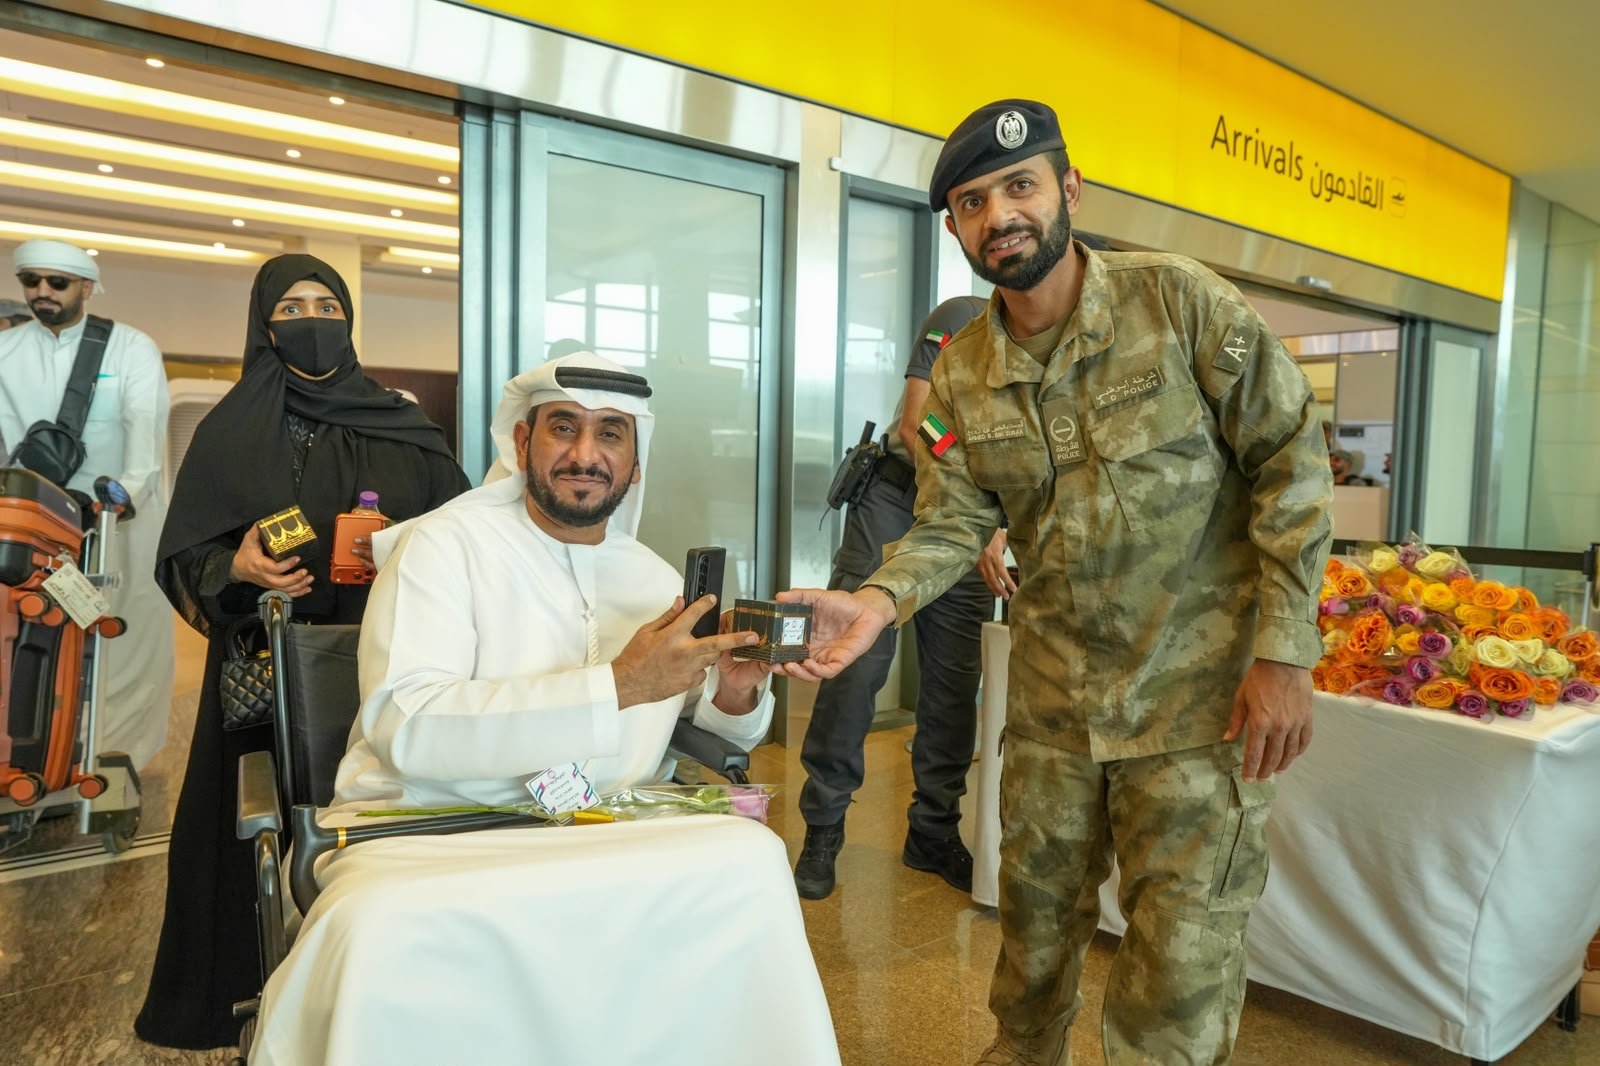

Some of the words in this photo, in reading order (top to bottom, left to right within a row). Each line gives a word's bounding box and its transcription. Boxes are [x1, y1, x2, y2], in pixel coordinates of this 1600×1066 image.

[1210, 114, 1304, 181] Arrivals
[1310, 161, 1385, 211] القادمون
[1223, 335, 1248, 363] A+
[1123, 379, 1160, 397] POLICE
[1055, 441, 1080, 453] الشرطة
[1056, 450, 1081, 461] POLICE
